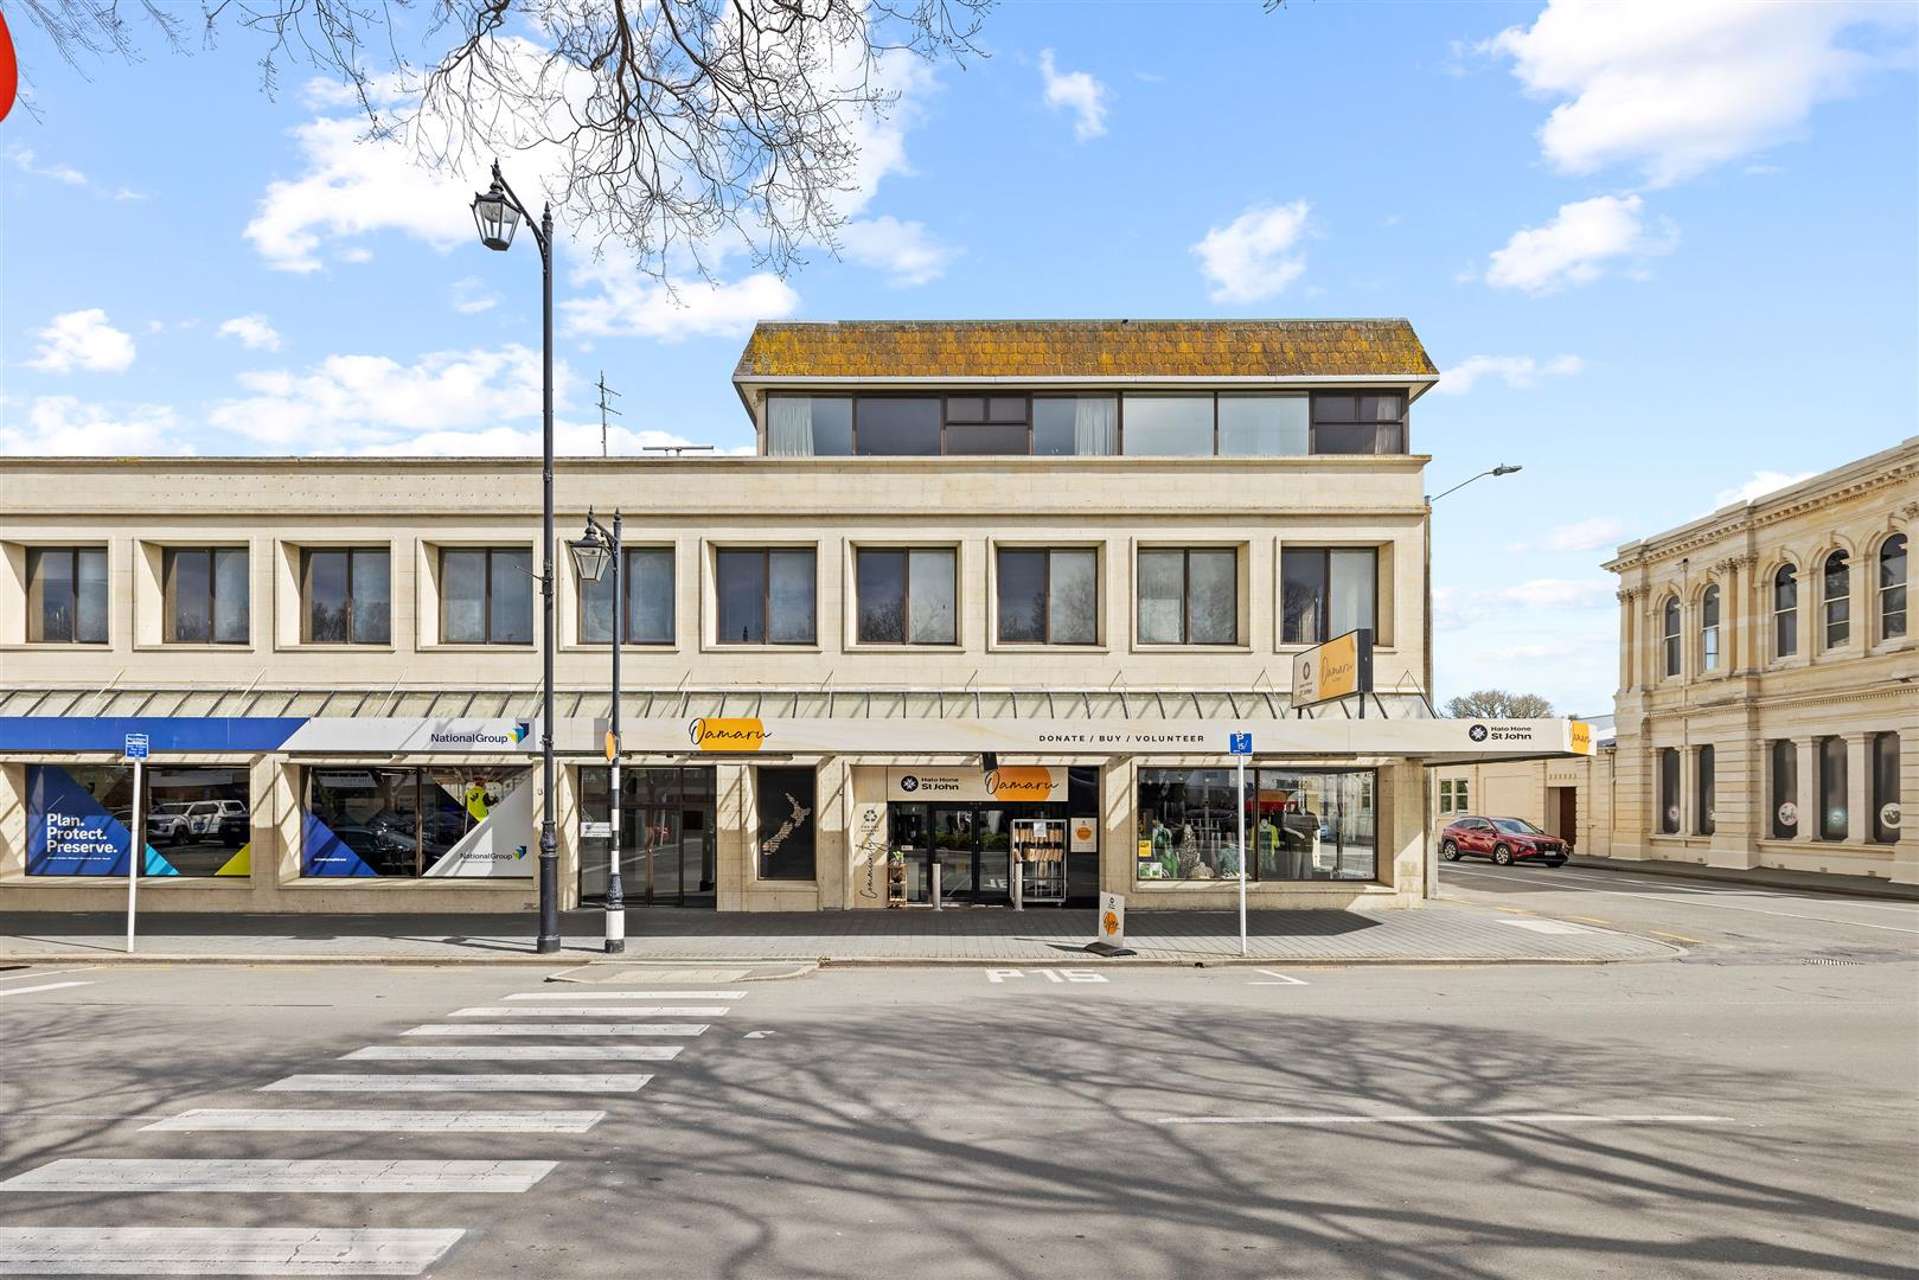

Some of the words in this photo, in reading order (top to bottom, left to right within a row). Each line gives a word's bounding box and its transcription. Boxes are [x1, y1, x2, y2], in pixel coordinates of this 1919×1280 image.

[688, 717, 773, 745] Oamaru
[1491, 732, 1503, 740] St
[1504, 732, 1532, 740] John
[430, 733, 508, 744] NationalGroup
[984, 769, 1059, 795] Oamaru
[47, 813, 85, 827] Plan.
[47, 826, 107, 840] Protect.
[47, 840, 118, 853] Preserve.
